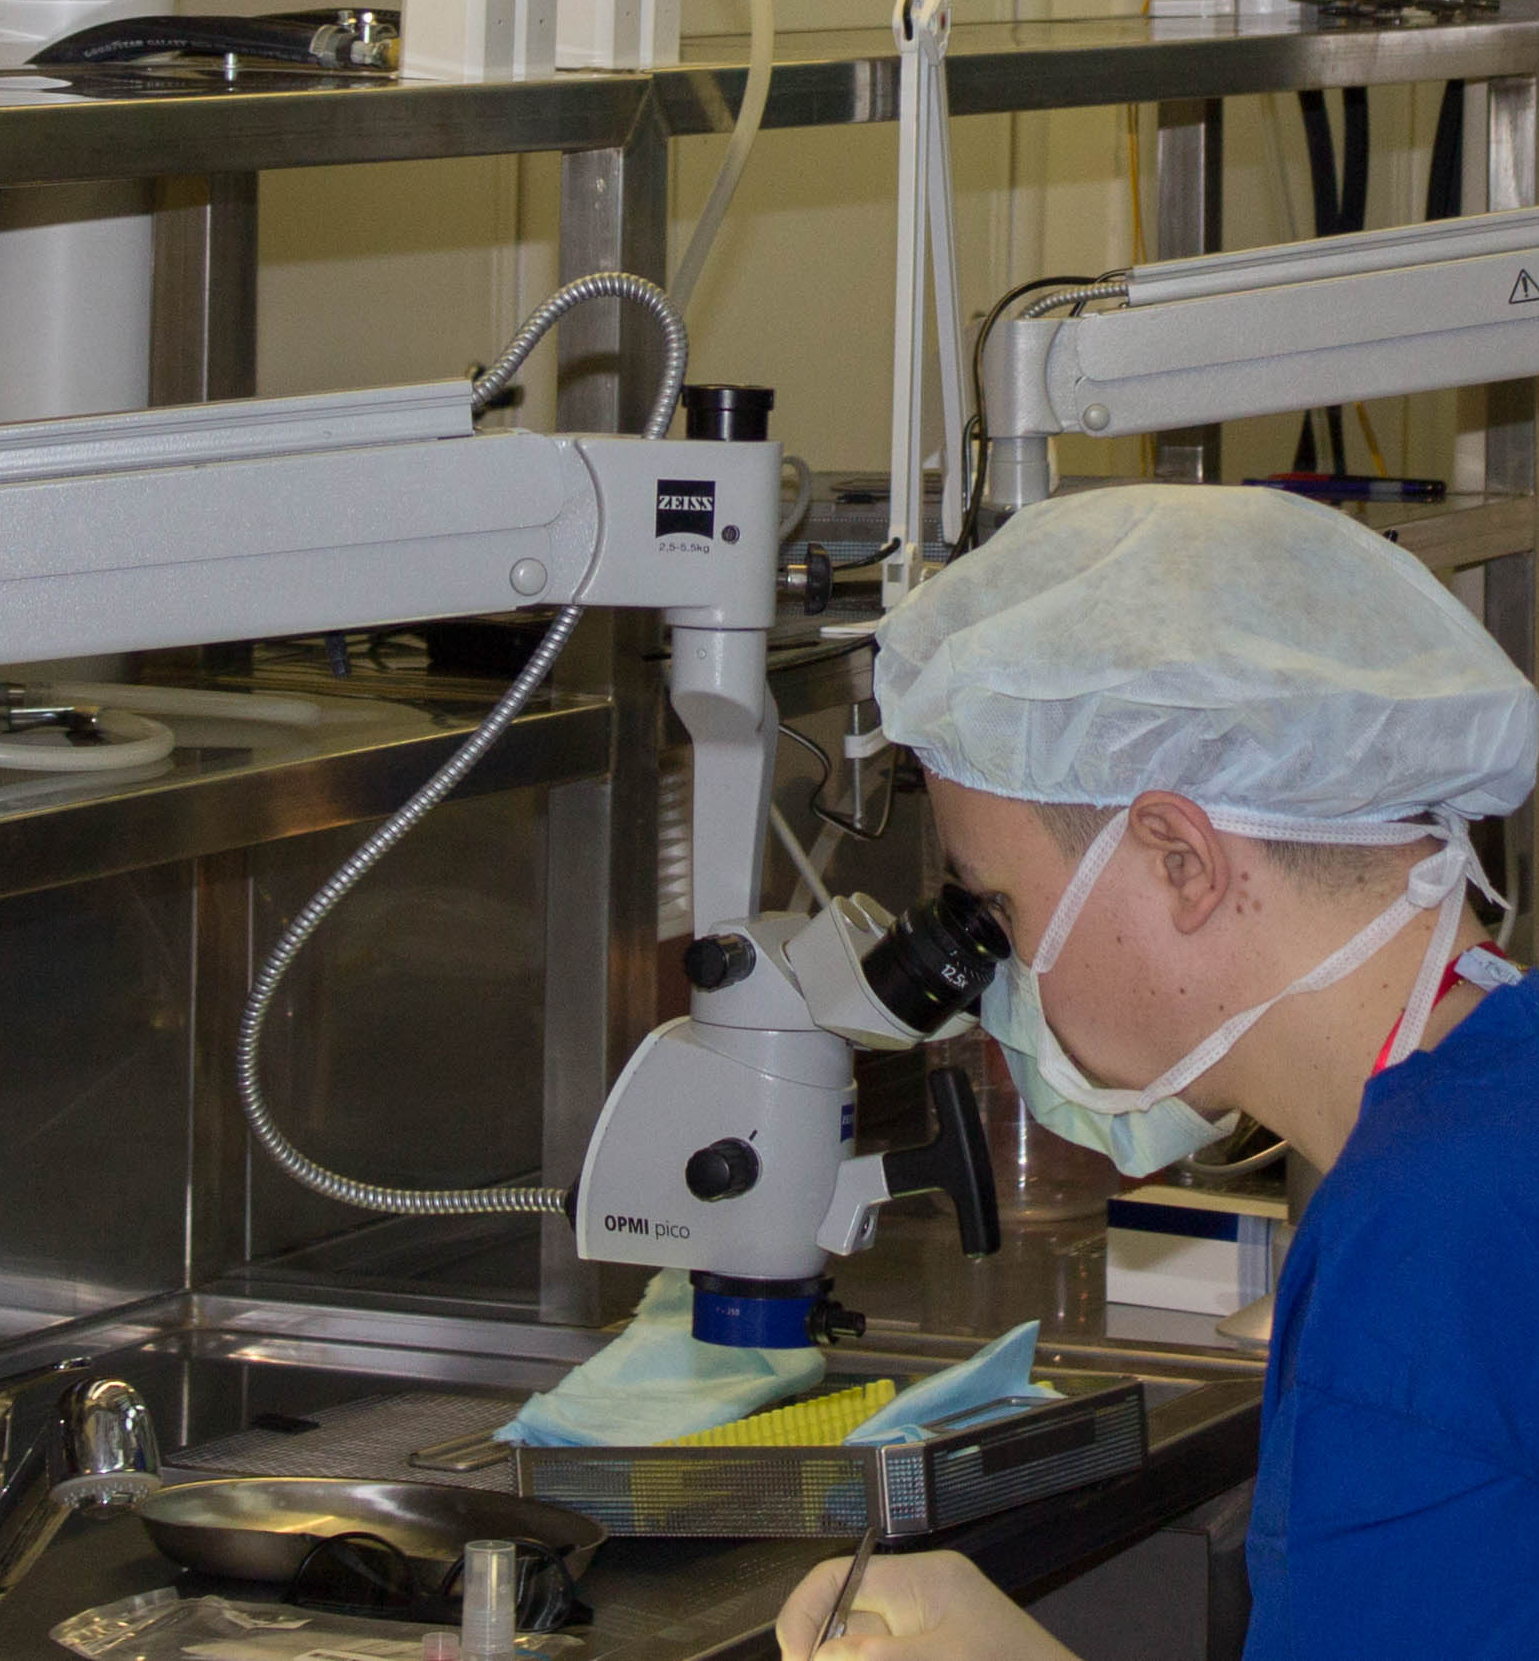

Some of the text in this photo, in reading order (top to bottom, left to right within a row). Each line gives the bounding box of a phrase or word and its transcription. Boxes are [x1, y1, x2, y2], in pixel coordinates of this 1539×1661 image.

[658, 495, 713, 511] ZEISS
[604, 1215, 690, 1240] OPMI pico
